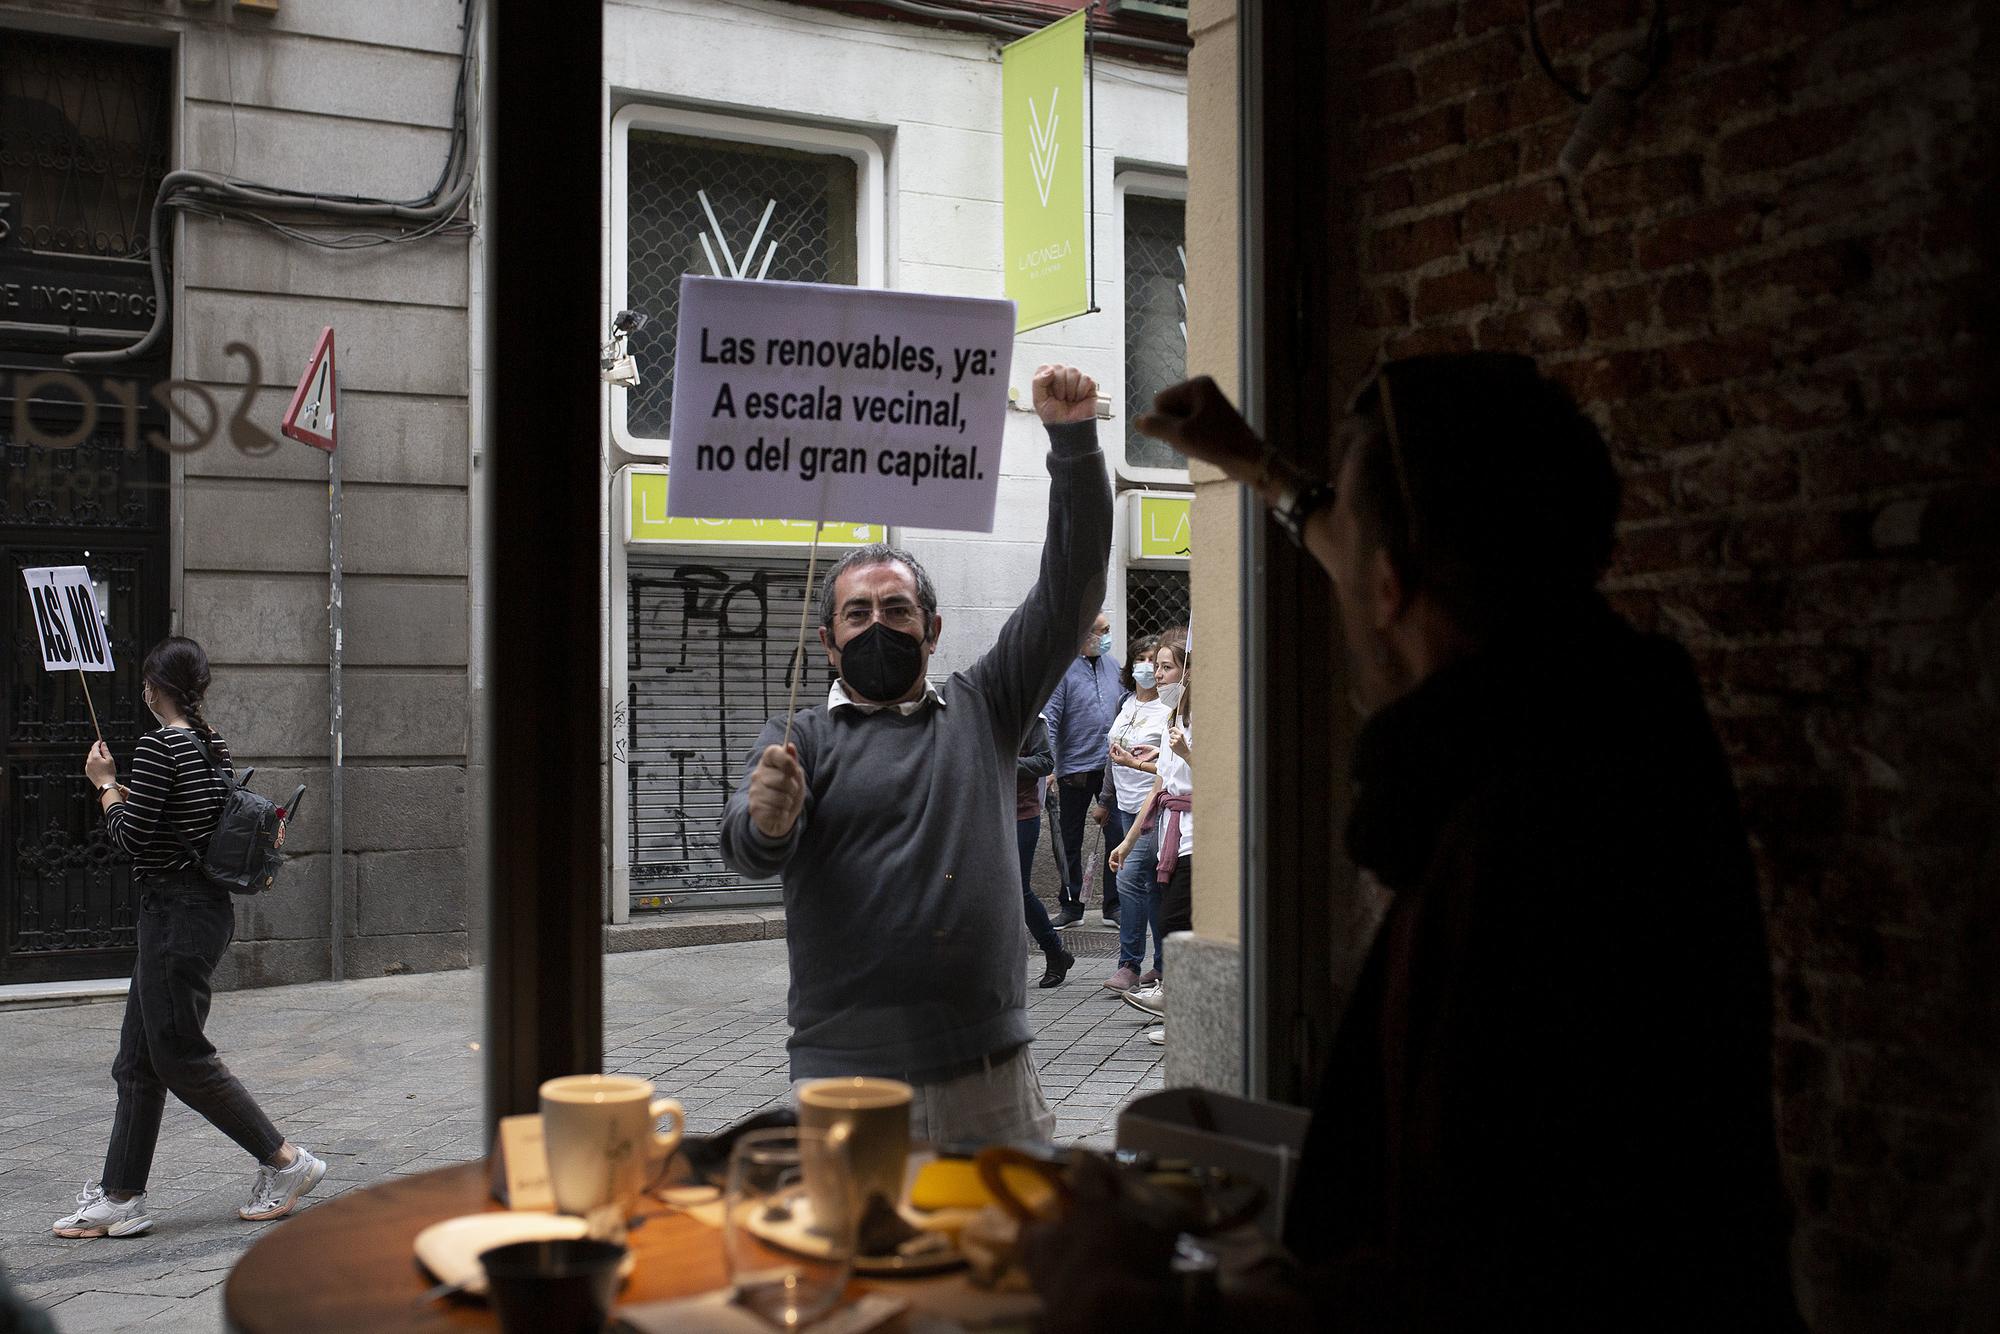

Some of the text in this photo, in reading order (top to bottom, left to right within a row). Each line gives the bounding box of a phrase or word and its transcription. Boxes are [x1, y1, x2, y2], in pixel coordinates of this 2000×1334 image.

[700, 328, 996, 383] Las renovables, ya:
[711, 382, 966, 433] A escala vecinal,
[696, 437, 984, 486] no del gran capital.
[32, 571, 105, 665] ASÍ NO
